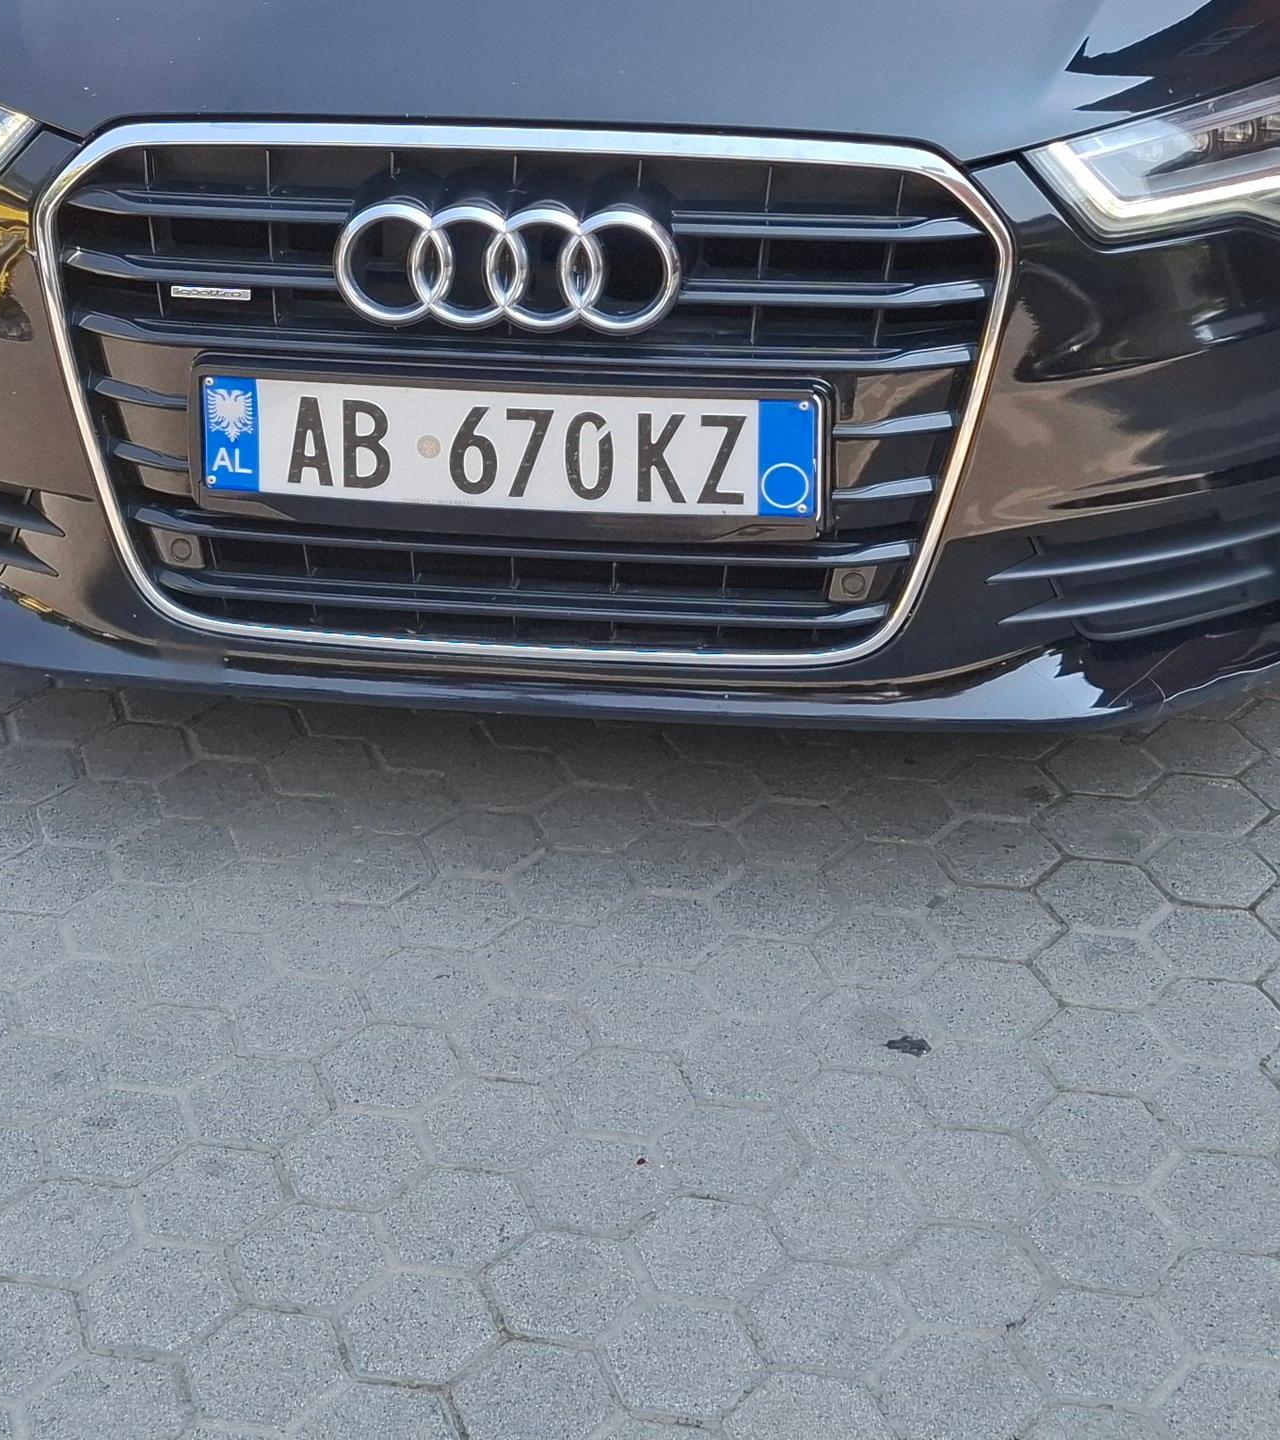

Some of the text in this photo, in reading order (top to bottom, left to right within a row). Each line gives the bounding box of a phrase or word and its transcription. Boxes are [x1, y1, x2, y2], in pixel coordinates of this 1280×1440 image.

[211, 445, 253, 475] AL
[286, 395, 748, 506] AB 670KZ
